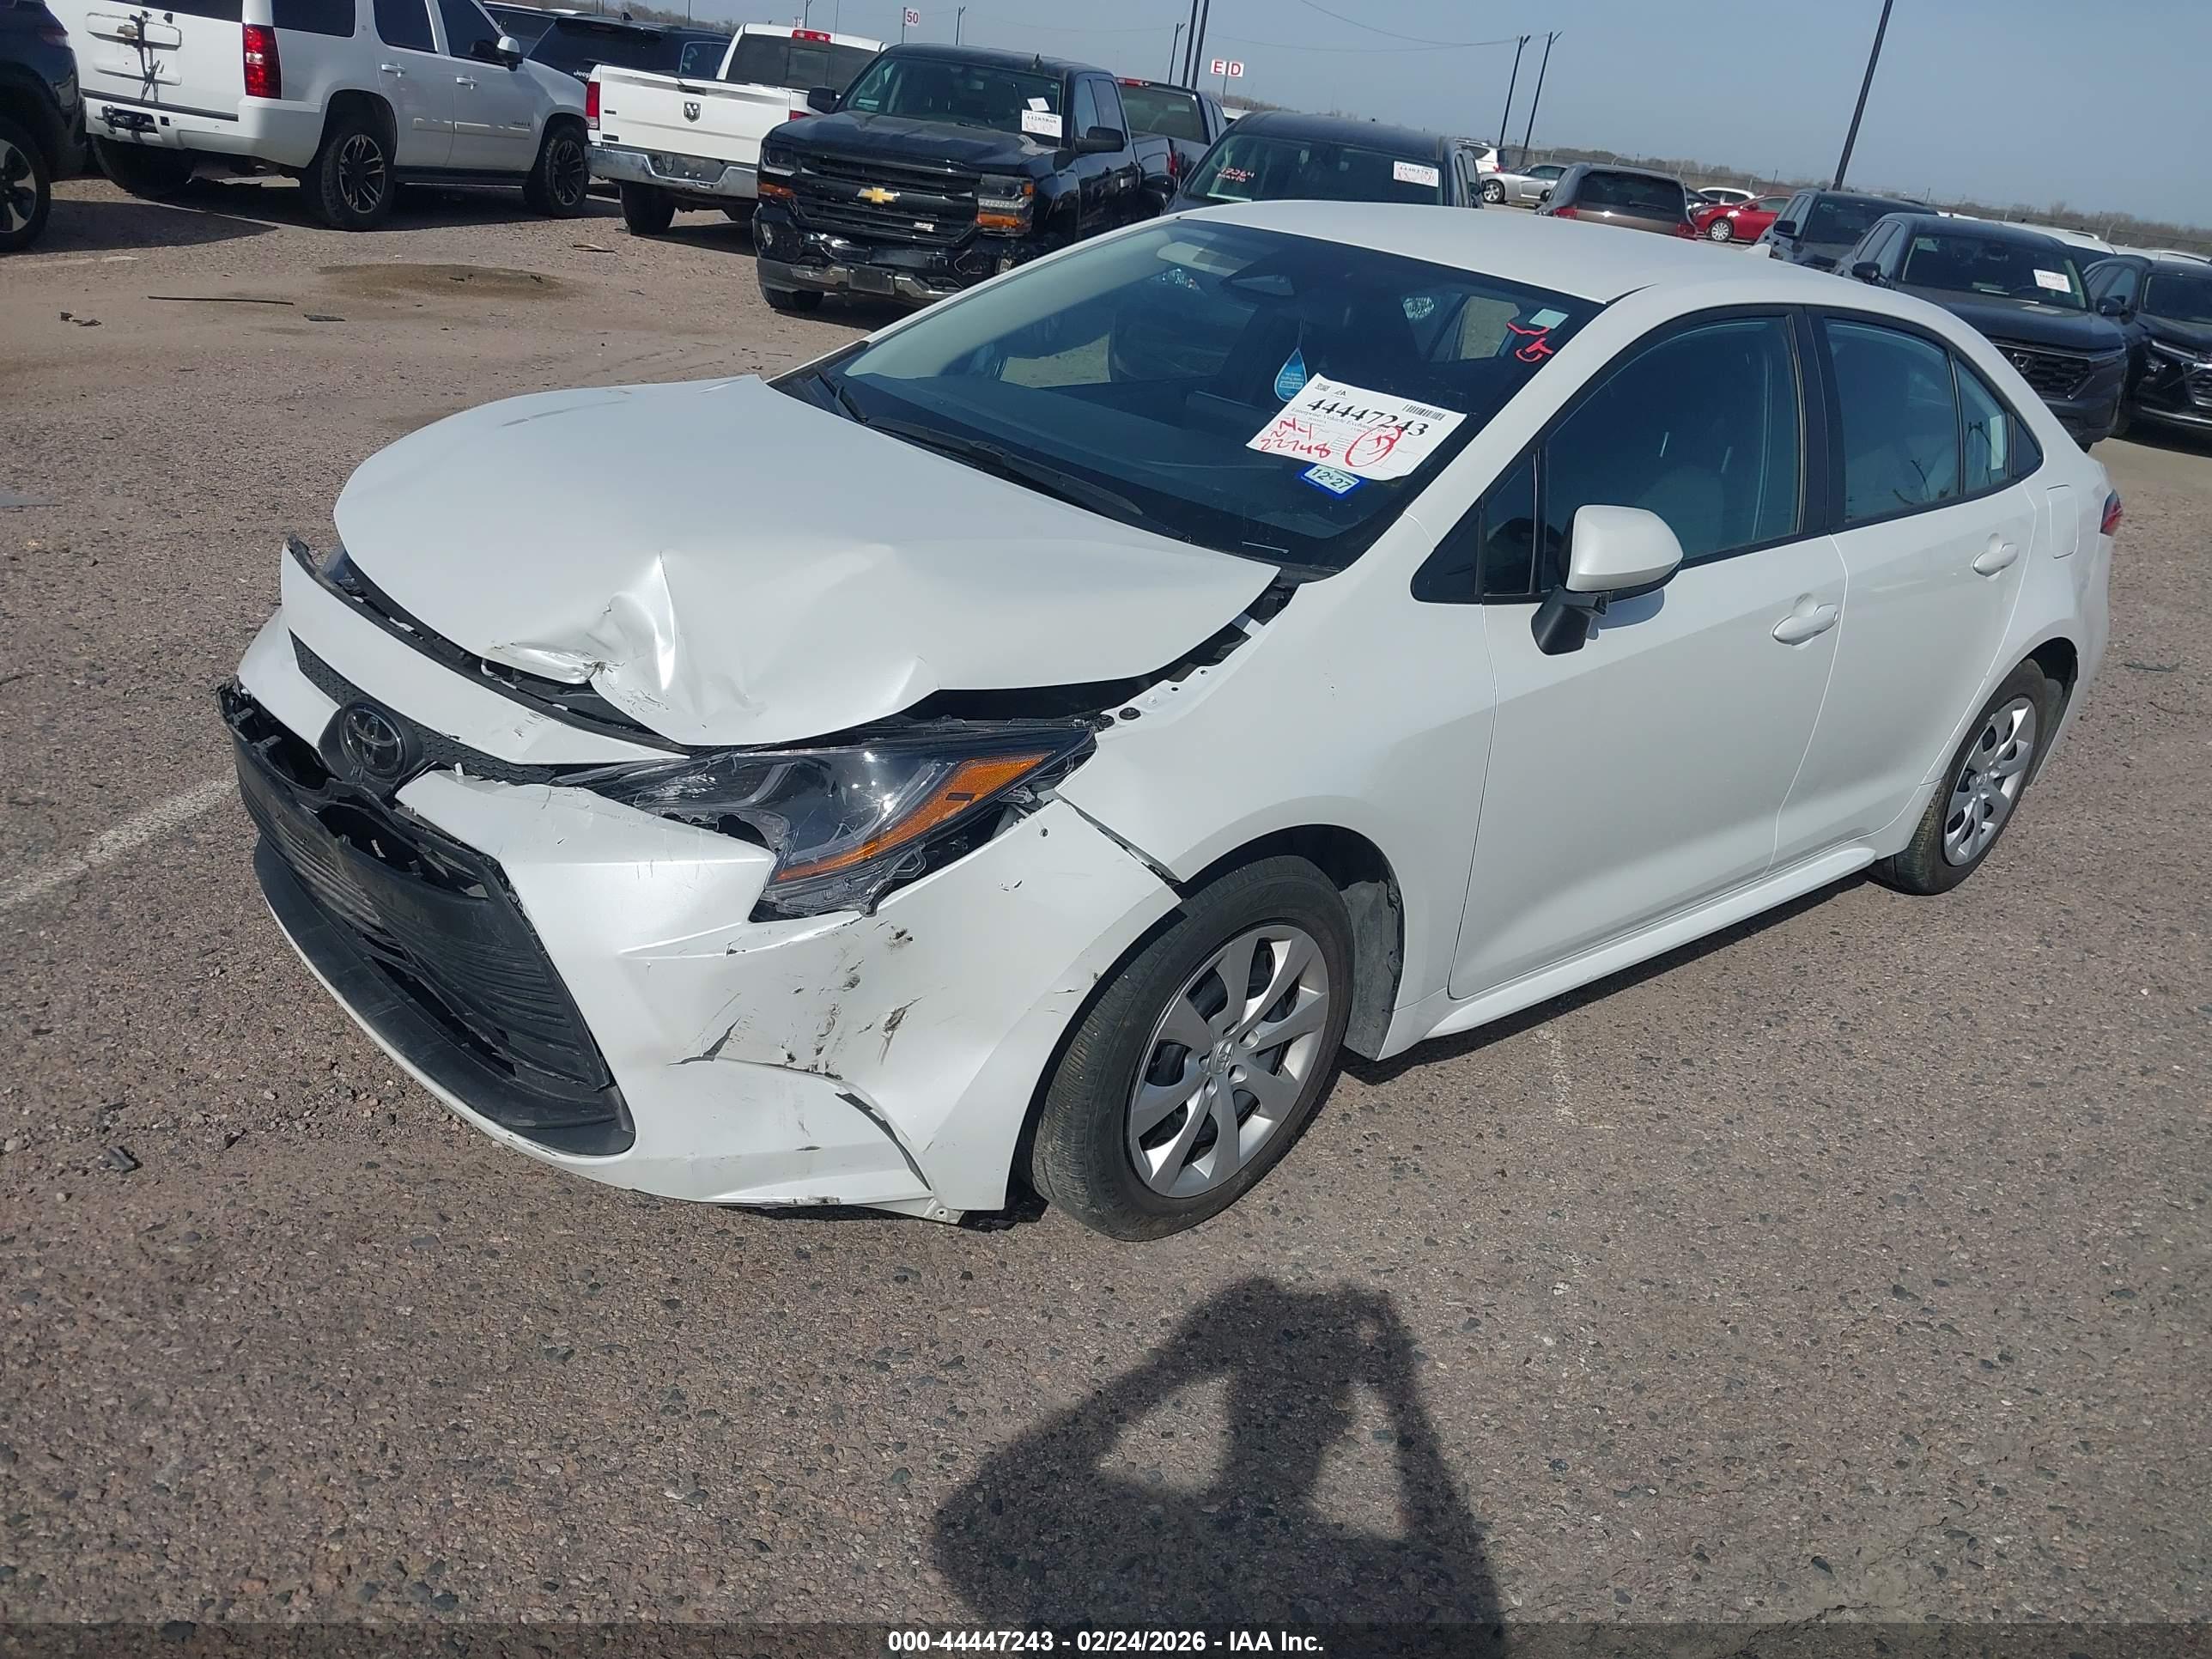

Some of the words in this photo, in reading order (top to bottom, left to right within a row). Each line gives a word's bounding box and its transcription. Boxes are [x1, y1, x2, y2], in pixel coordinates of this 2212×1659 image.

[907, 11, 919, 24] 50
[1213, 61, 1224, 74] E
[1231, 63, 1241, 76] D
[573, 70, 591, 79] Jeep
[1307, 398, 1430, 437] 44447243
